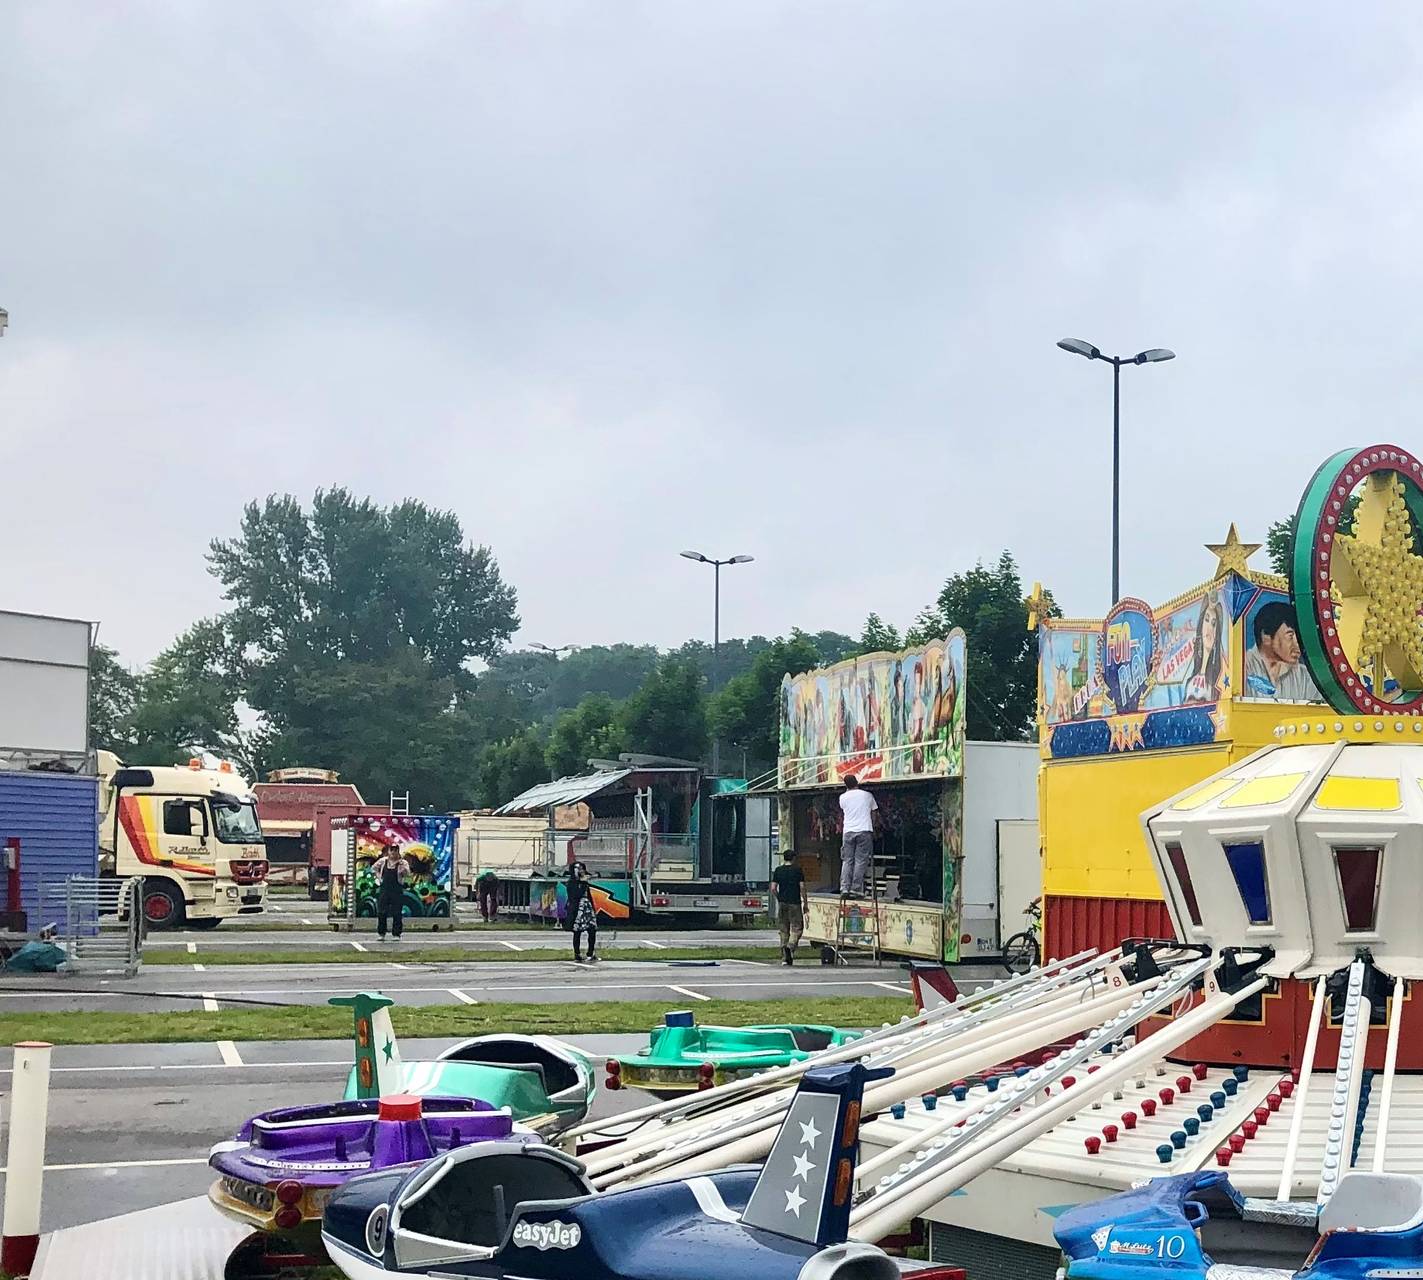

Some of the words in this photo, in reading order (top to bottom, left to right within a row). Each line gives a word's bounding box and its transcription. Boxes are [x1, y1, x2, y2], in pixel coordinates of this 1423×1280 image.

[1176, 641, 1195, 666] VEGA
[1112, 976, 1122, 988] 8
[1209, 981, 1216, 992] 9
[373, 1215, 384, 1242] 9
[513, 1222, 581, 1248] easyJet
[1156, 1234, 1186, 1259] 10
